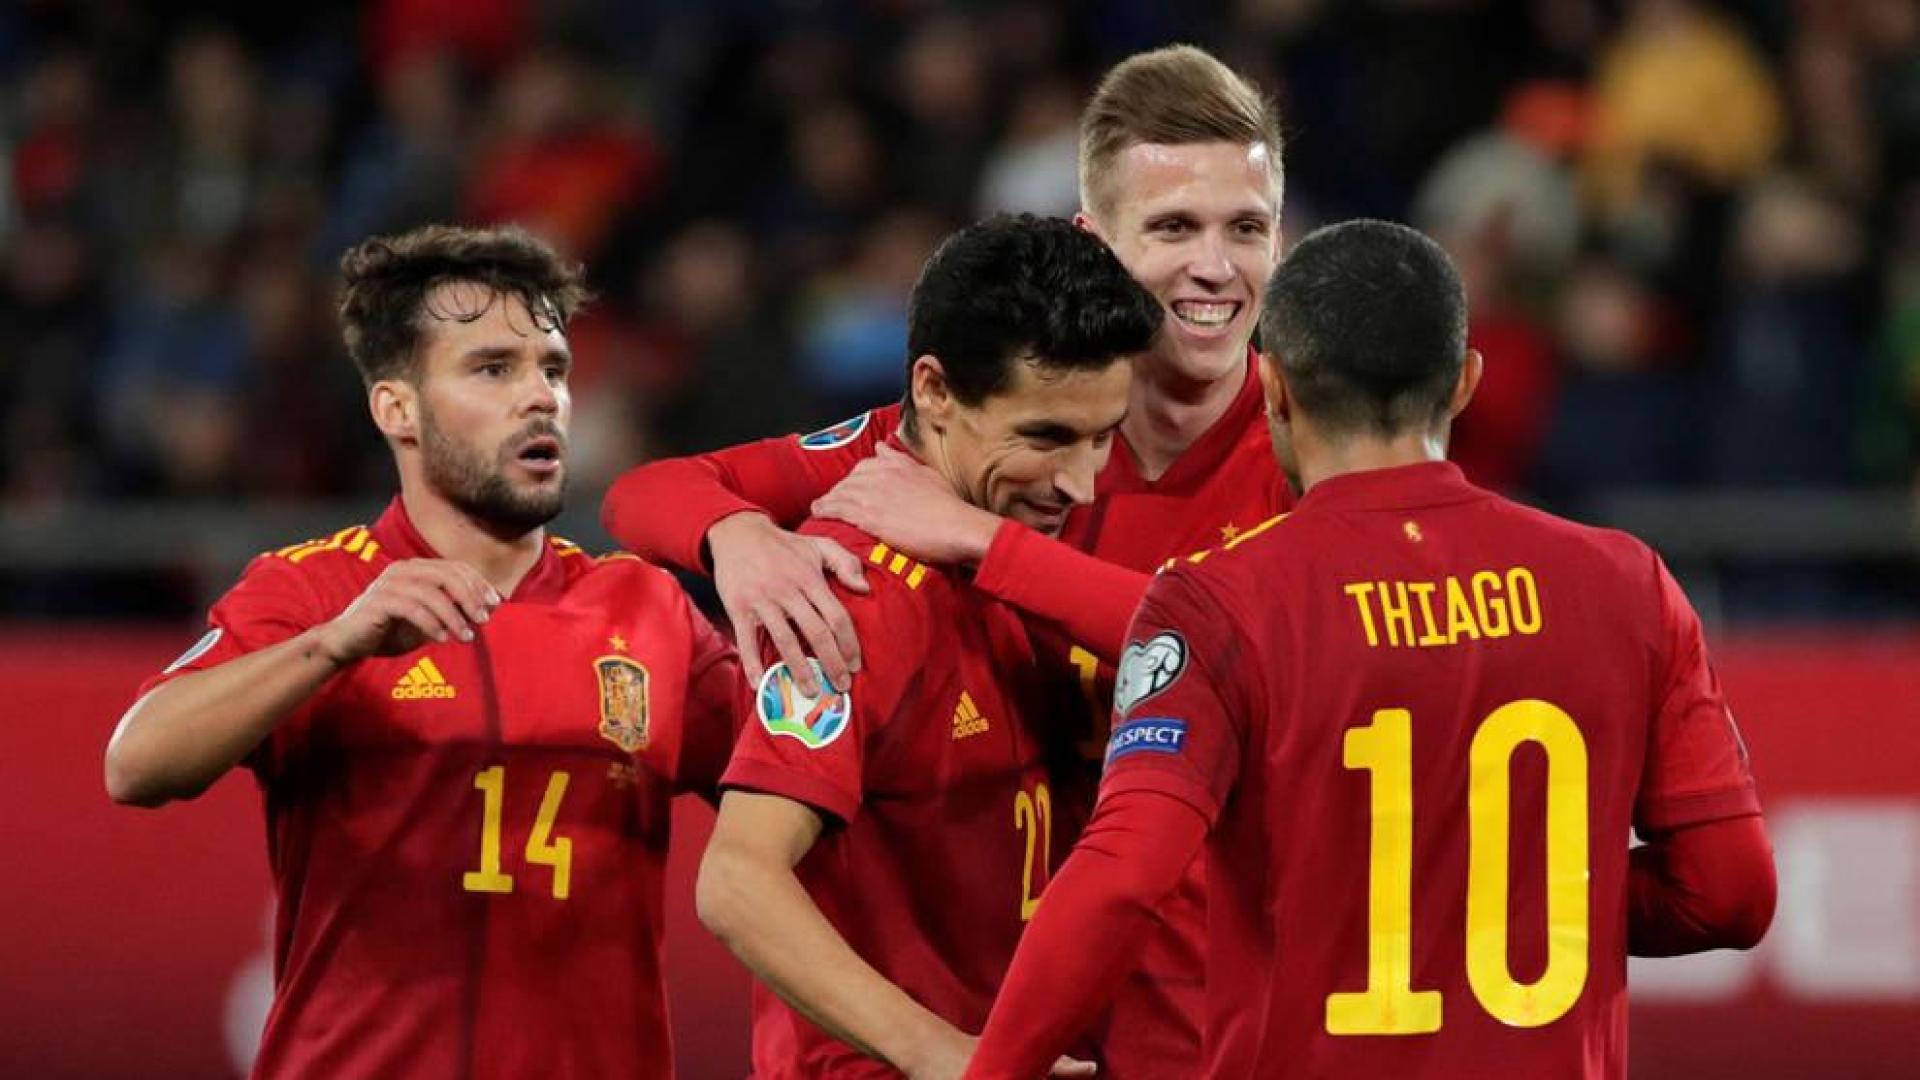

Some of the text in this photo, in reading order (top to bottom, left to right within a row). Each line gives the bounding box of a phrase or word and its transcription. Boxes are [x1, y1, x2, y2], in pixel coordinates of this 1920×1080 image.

[1344, 566, 1543, 647] THIAGO
[392, 684, 457, 699] adidas
[1112, 726, 1186, 749] ESPECT
[463, 765, 573, 900] 14
[1325, 698, 1590, 1036] 10
